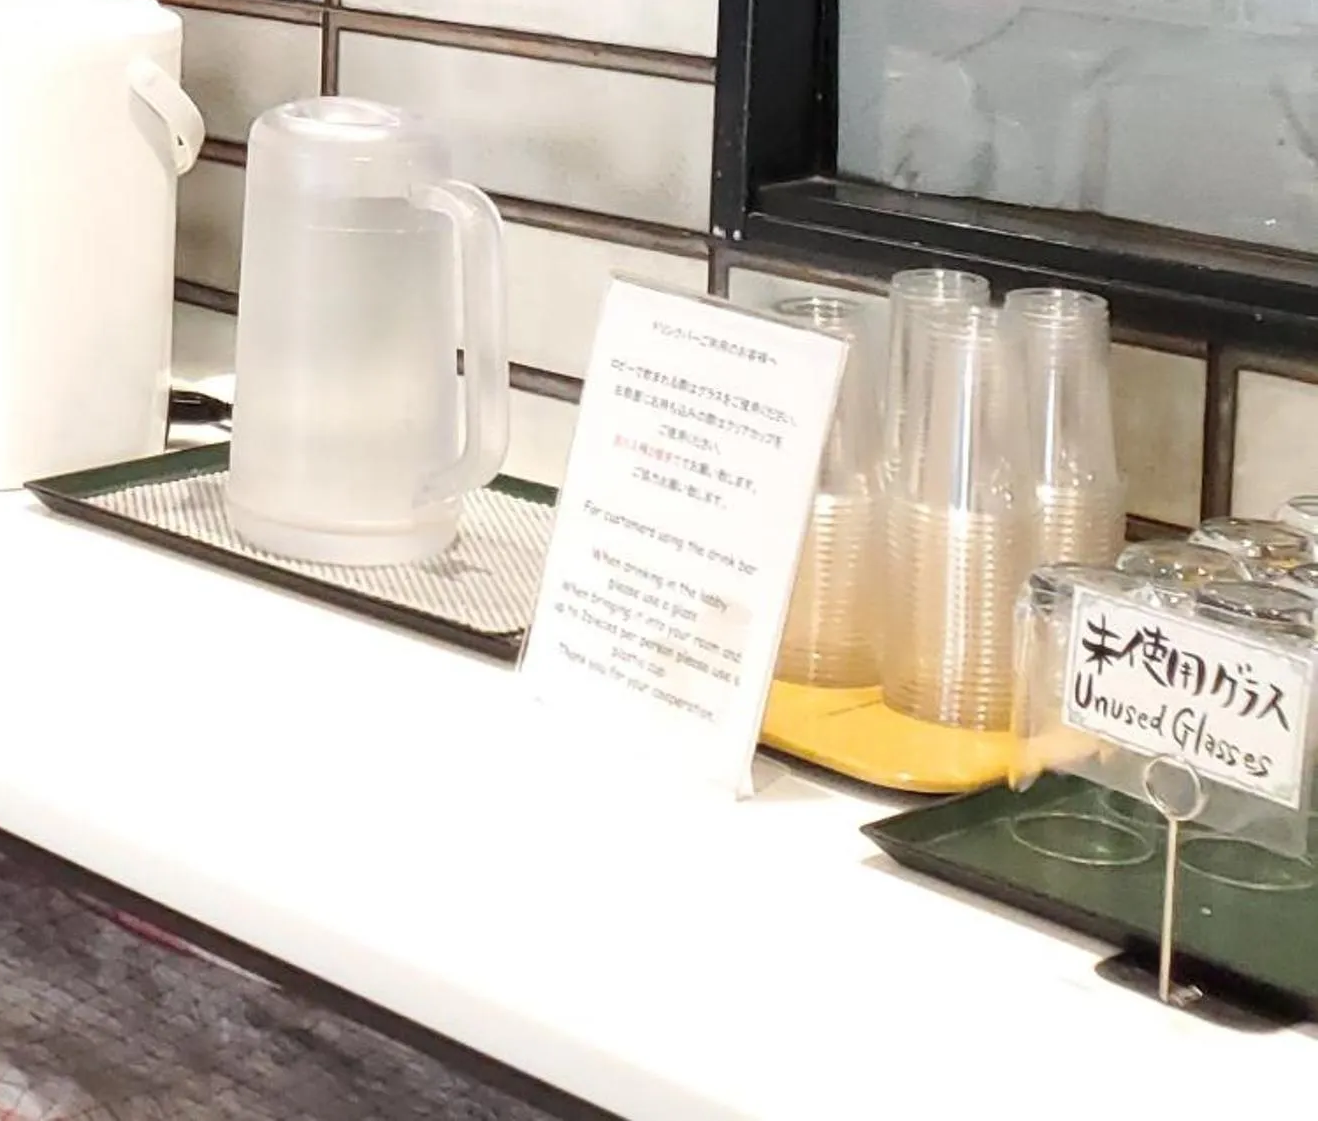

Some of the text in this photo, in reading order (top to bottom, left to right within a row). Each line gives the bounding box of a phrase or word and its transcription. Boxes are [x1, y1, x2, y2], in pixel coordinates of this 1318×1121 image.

[583, 499, 602, 516] For
[603, 511, 655, 539] customers
[657, 530, 684, 551] using
[687, 539, 705, 557] the
[608, 578, 639, 600] please
[1082, 613, 1290, 732] 未使用グラス
[1074, 670, 1274, 779] Unused Glasses
